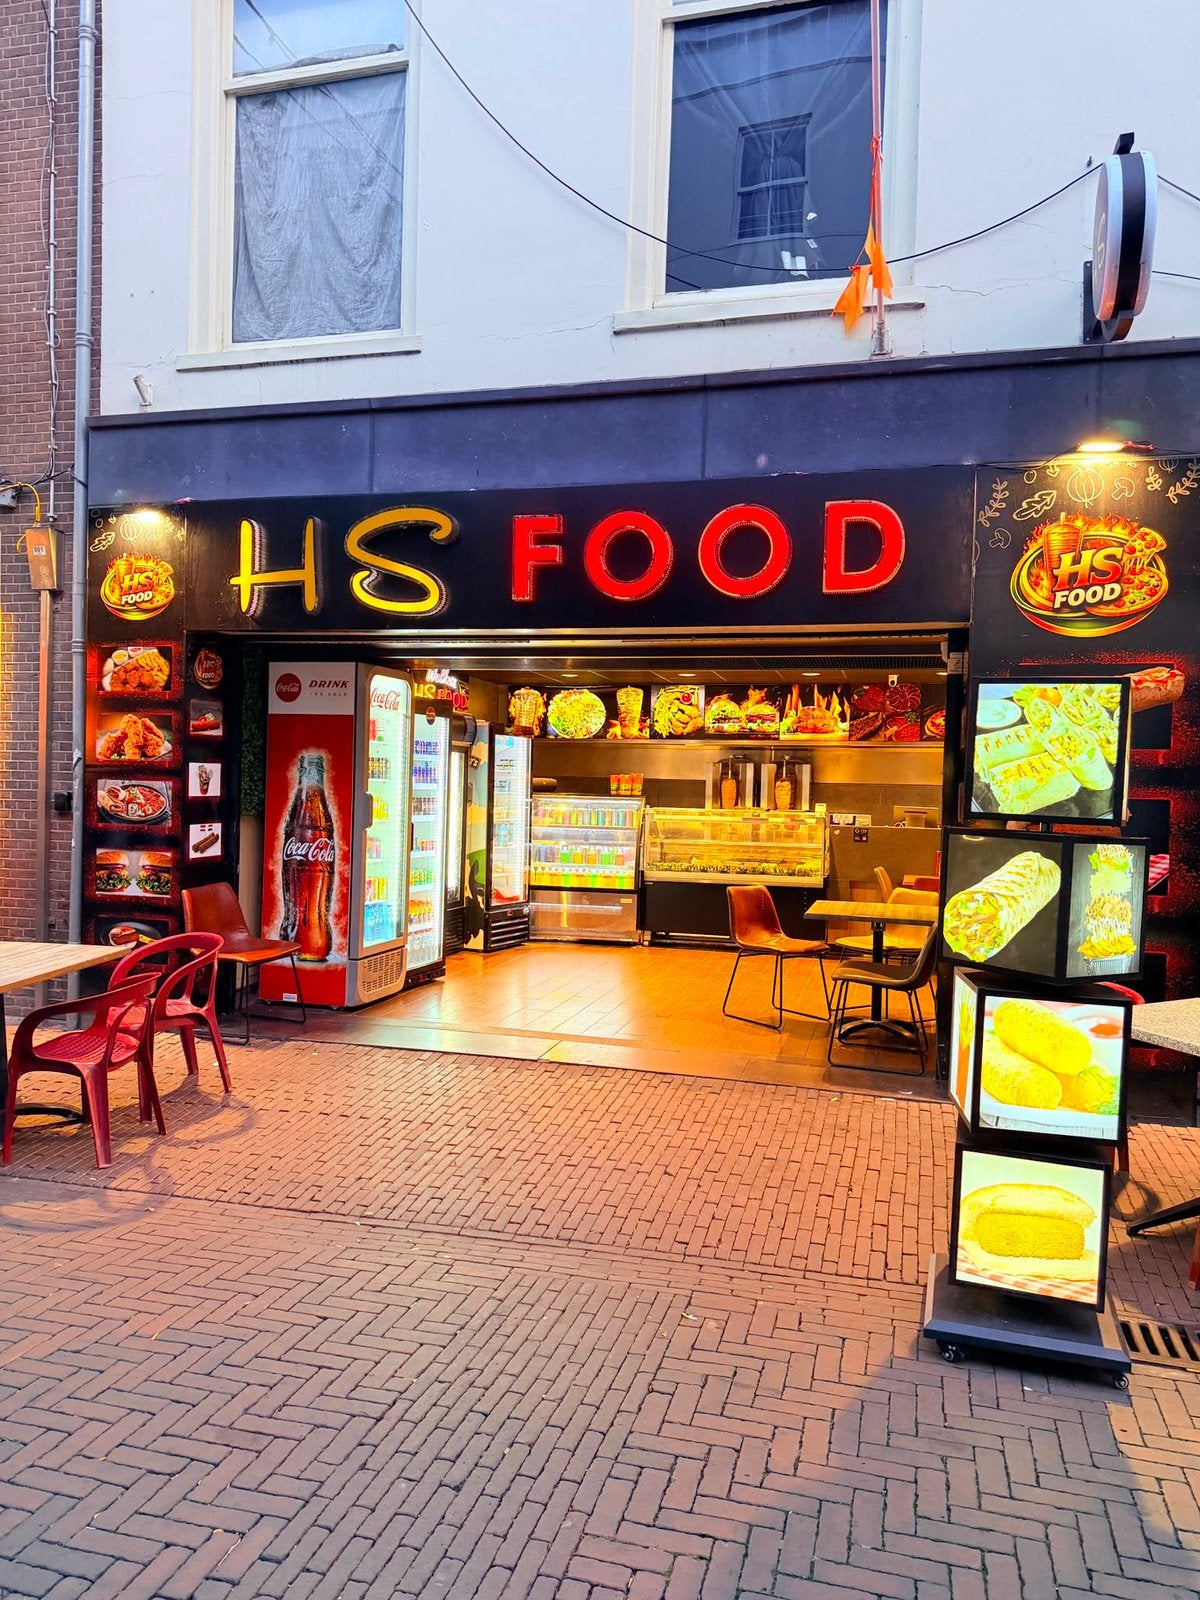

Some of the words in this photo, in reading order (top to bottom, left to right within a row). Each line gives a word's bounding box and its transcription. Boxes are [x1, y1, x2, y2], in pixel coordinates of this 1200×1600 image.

[230, 504, 457, 615] HS
[511, 499, 906, 602] FOOD
[1052, 547, 1125, 591] HS
[120, 571, 154, 596] HS
[121, 590, 153, 605] FOOD
[1053, 583, 1122, 610] FOOD
[202, 660, 215, 672] HS
[308, 680, 350, 689] DRINK
